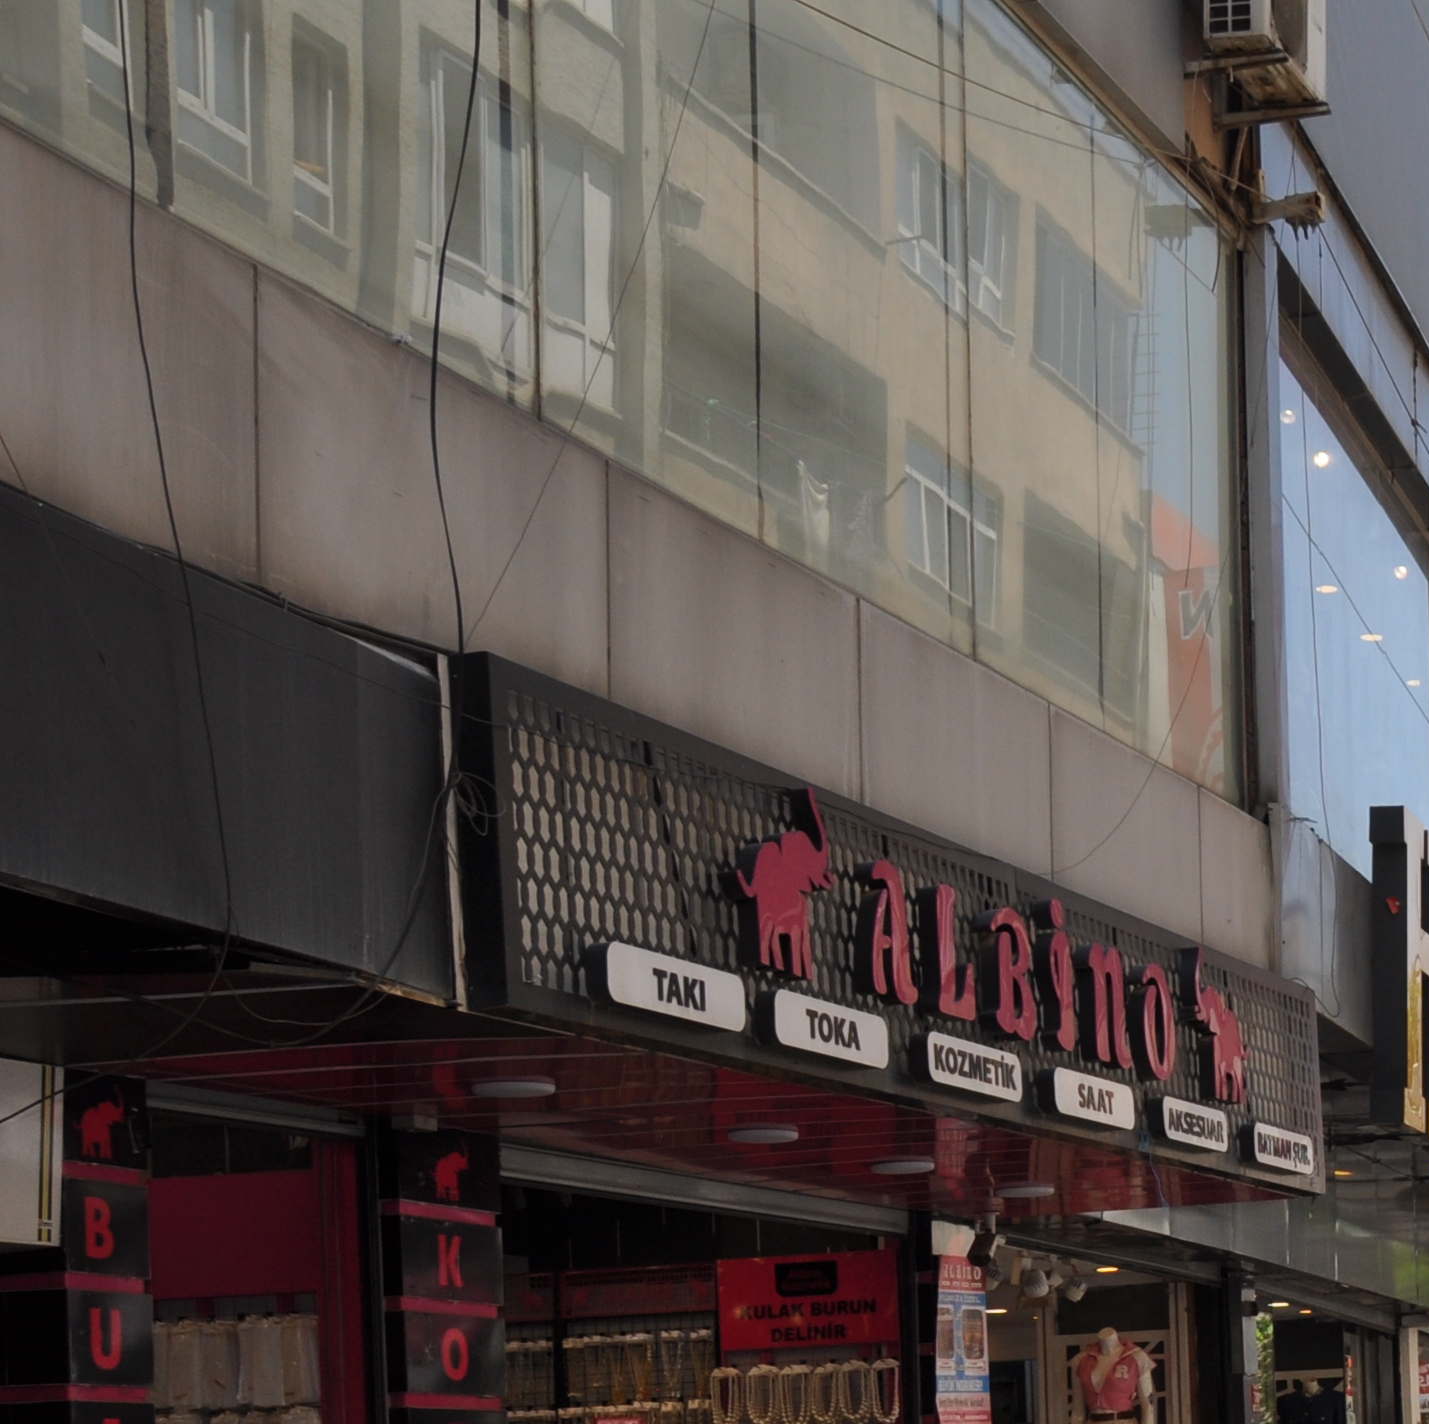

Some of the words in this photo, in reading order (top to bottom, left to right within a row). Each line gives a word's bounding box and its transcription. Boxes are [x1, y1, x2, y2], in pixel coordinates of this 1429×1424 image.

[653, 968, 707, 1012] TAKI
[806, 1009, 861, 1051] TOKA
[933, 1044, 1018, 1092] KOZMETİK
[1077, 1083, 1115, 1116] SAAT
[1168, 1106, 1225, 1144] AKSESUAR
[1257, 1132, 1291, 1161] BATMAN
[738, 1302, 806, 1322] KULAK
[810, 1298, 877, 1318] BURUN
[770, 1324, 847, 1342] DELİNİR
